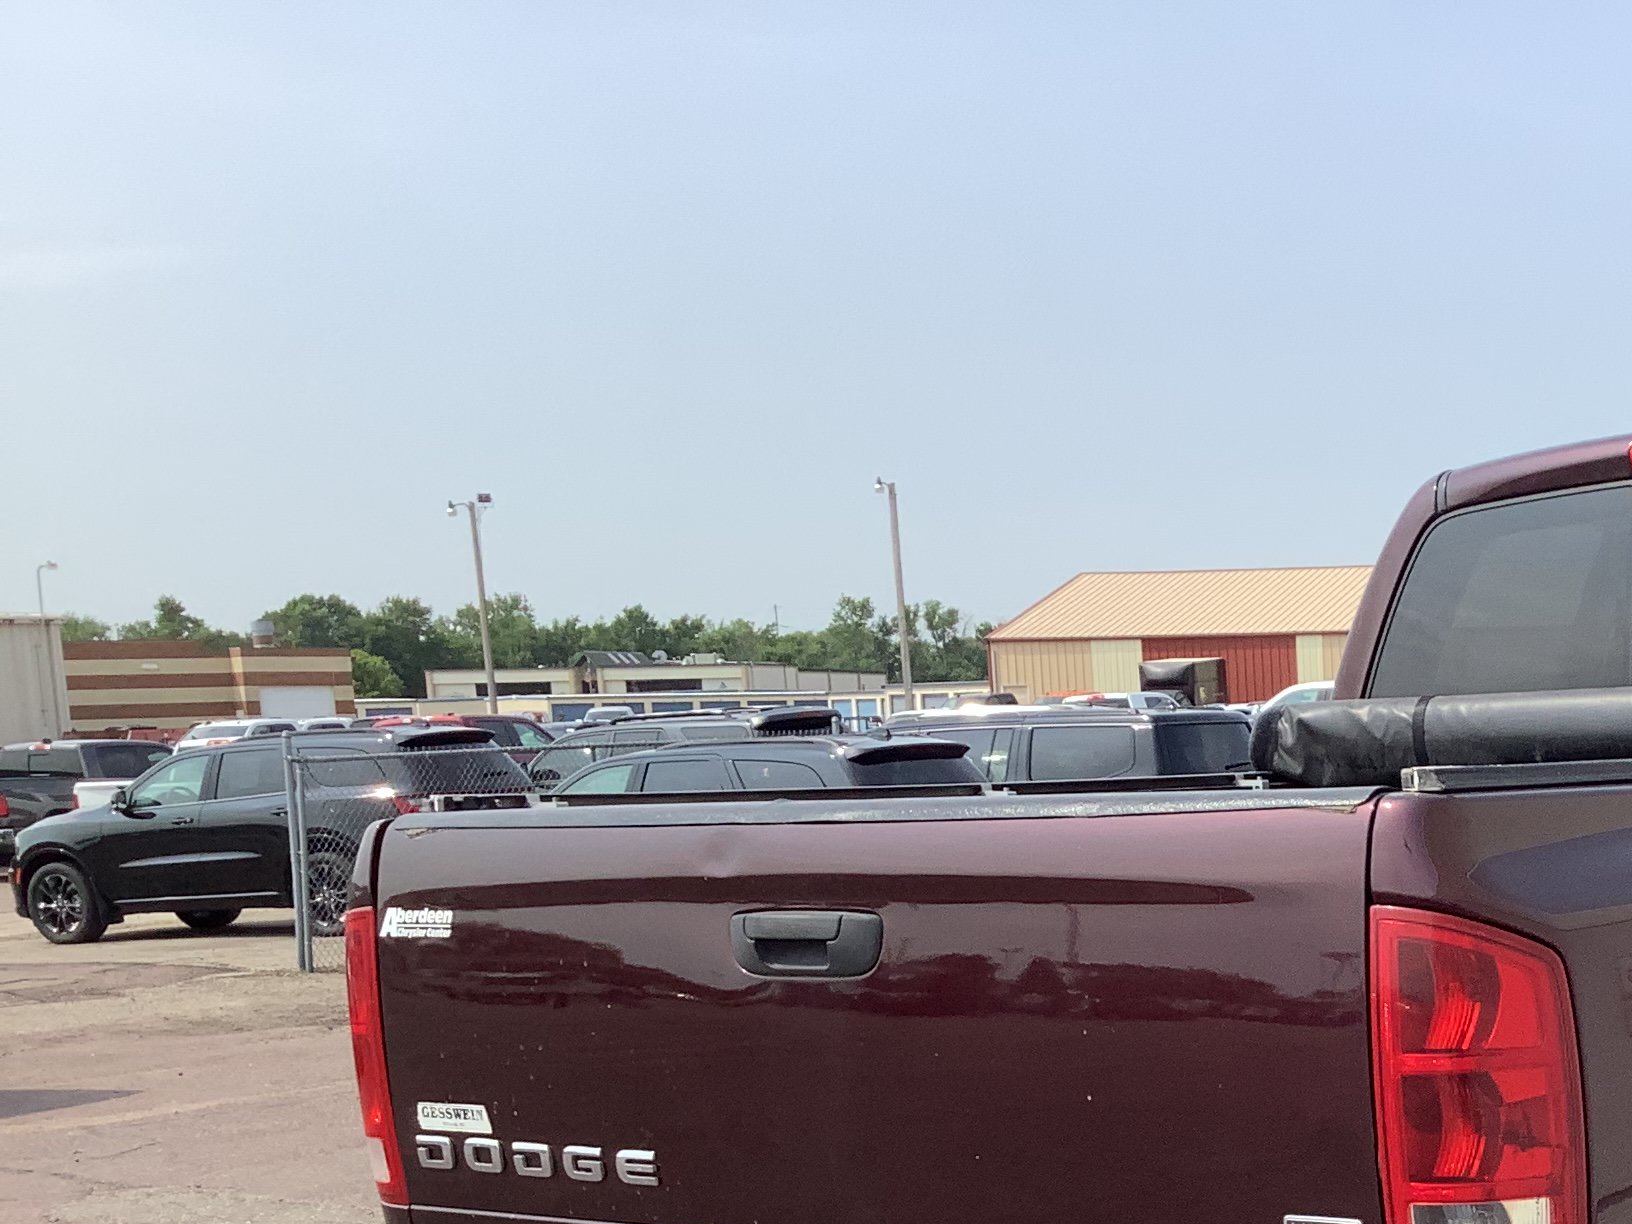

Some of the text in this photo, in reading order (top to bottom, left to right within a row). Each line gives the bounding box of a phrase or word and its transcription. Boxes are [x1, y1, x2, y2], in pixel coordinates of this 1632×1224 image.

[379, 907, 453, 937] Aberdeen
[421, 1105, 485, 1121] GESSWEIN
[415, 1135, 659, 1186] DODGE
